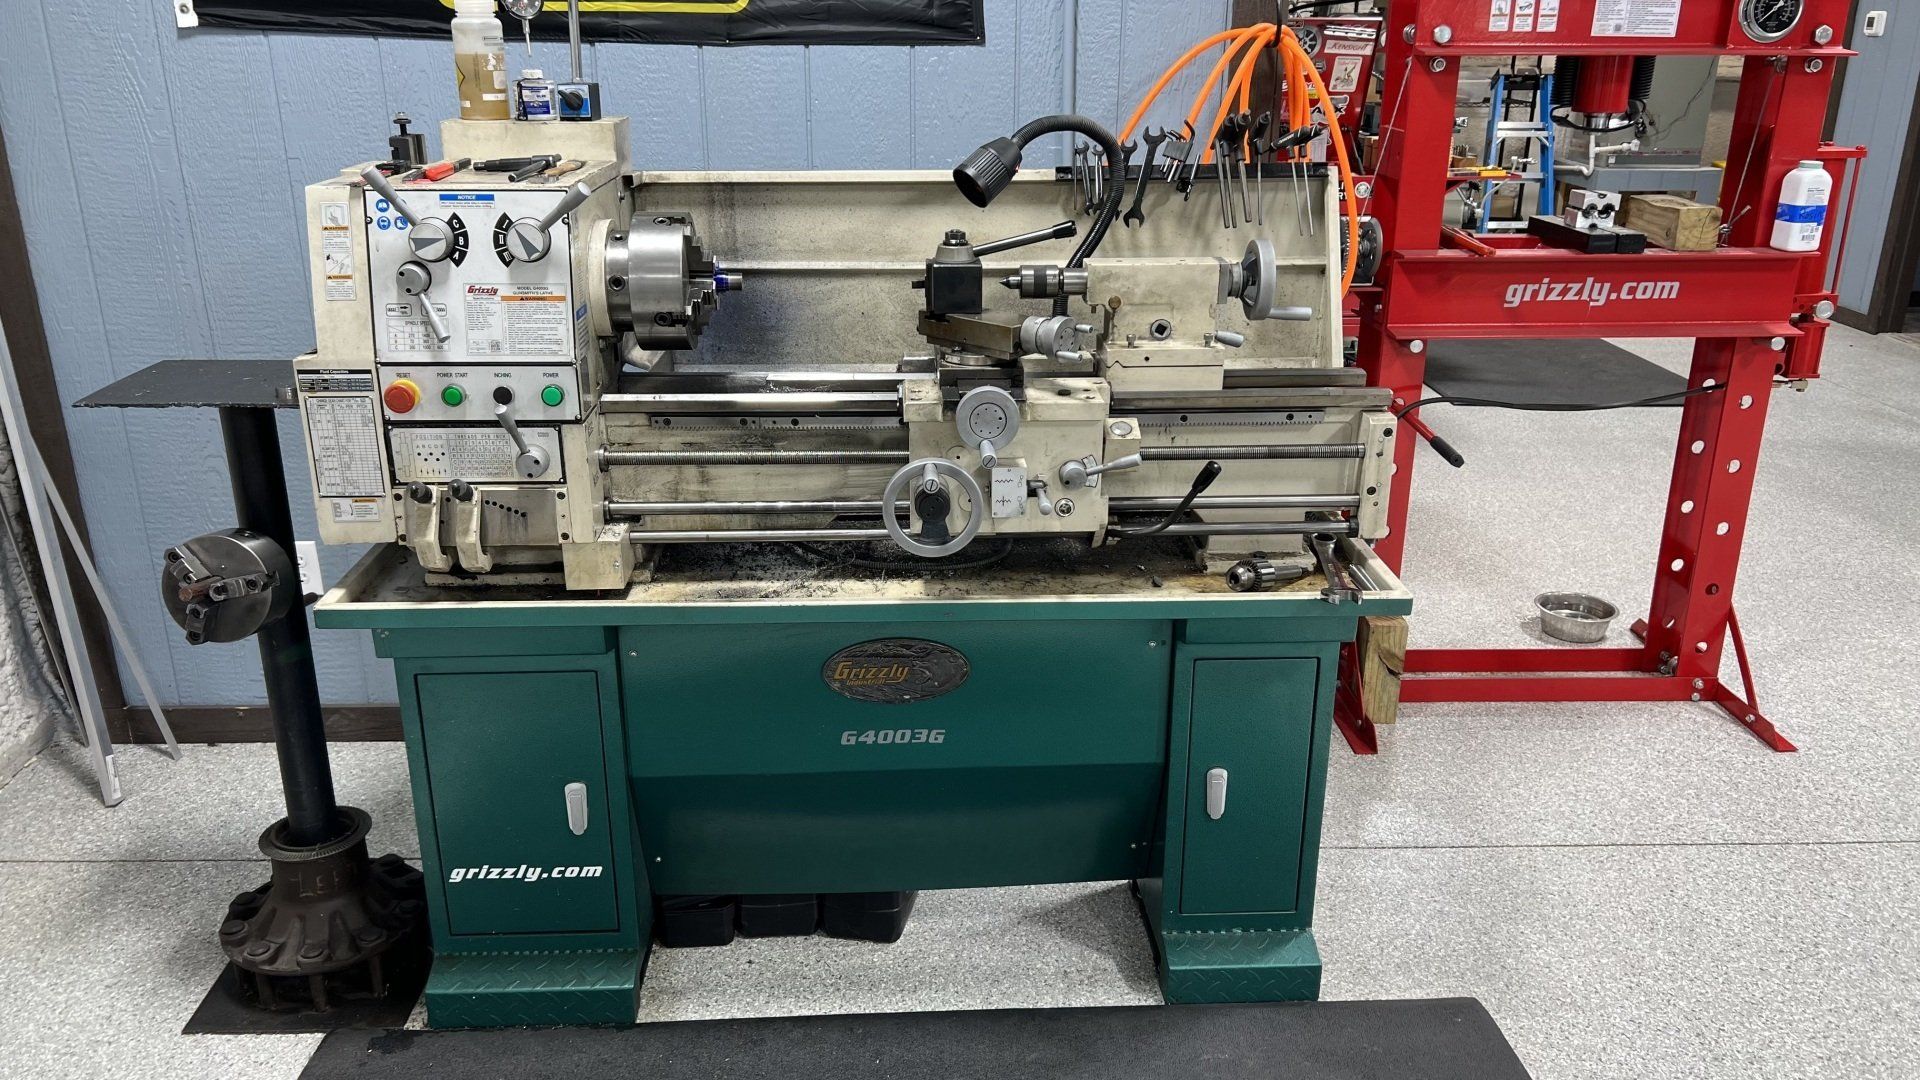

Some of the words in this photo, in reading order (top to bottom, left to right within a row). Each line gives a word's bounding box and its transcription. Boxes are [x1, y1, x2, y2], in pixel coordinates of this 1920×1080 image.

[452, 219, 460, 229] C
[458, 236, 465, 246] B
[452, 251, 459, 260] A
[467, 285, 499, 296] Grizzly
[1503, 276, 1680, 307] grizzly.com
[833, 661, 910, 683] Grizzly
[846, 678, 886, 686] Industrial
[840, 728, 946, 745] G4003G
[448, 864, 603, 883] grizzly.com
